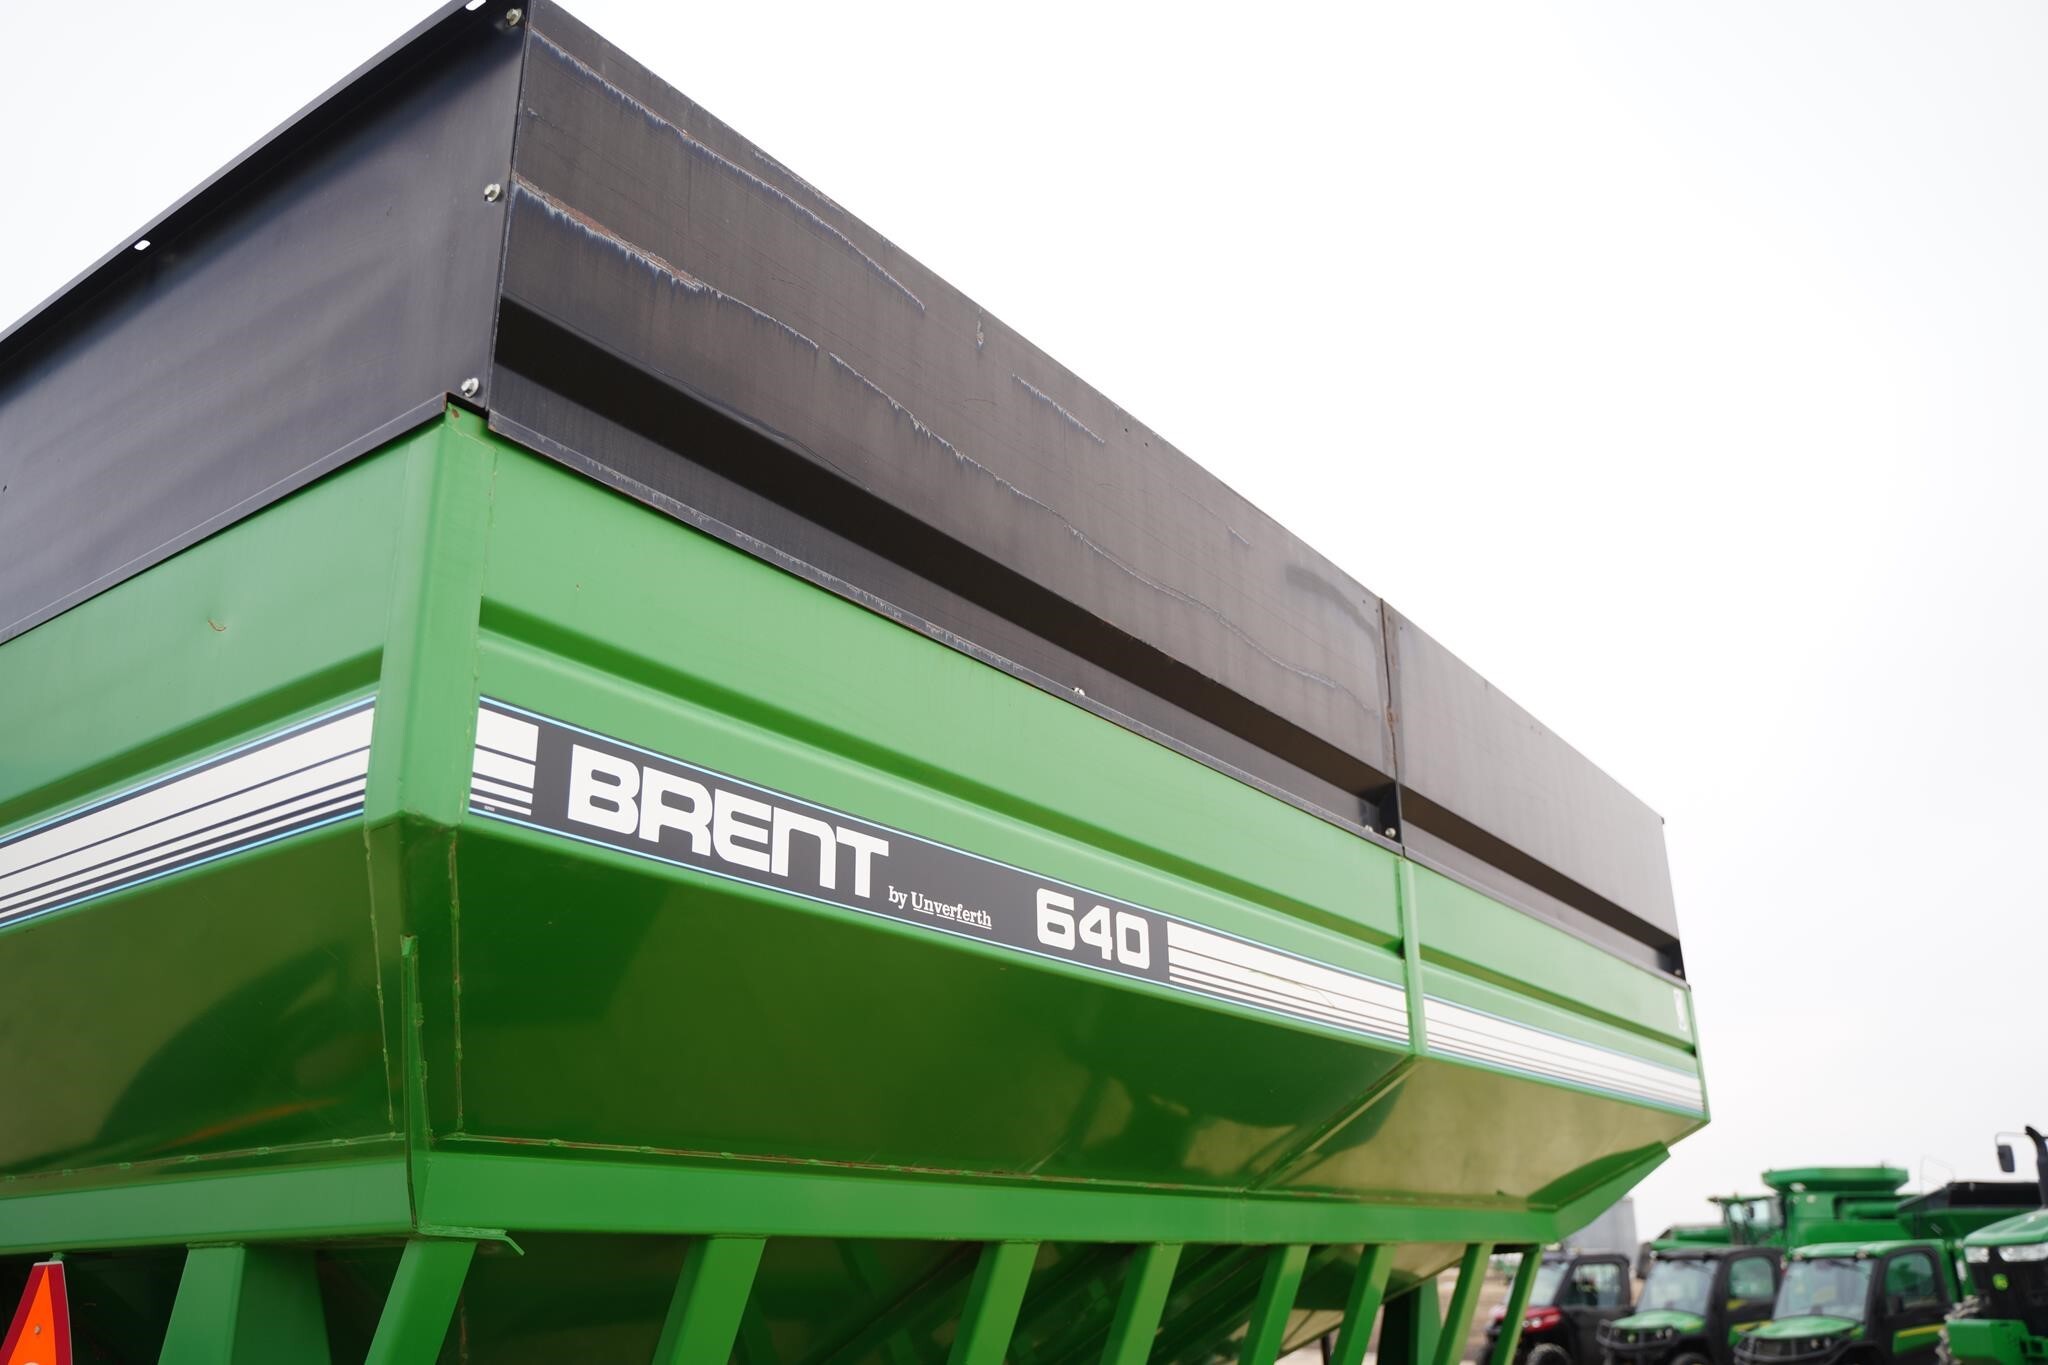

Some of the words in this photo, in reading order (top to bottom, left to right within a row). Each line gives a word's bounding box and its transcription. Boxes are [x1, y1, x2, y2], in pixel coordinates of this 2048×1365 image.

[568, 744, 889, 898] BRENT
[888, 885, 908, 910] by
[911, 891, 992, 930] Unverferth
[1036, 888, 1150, 969] 640
